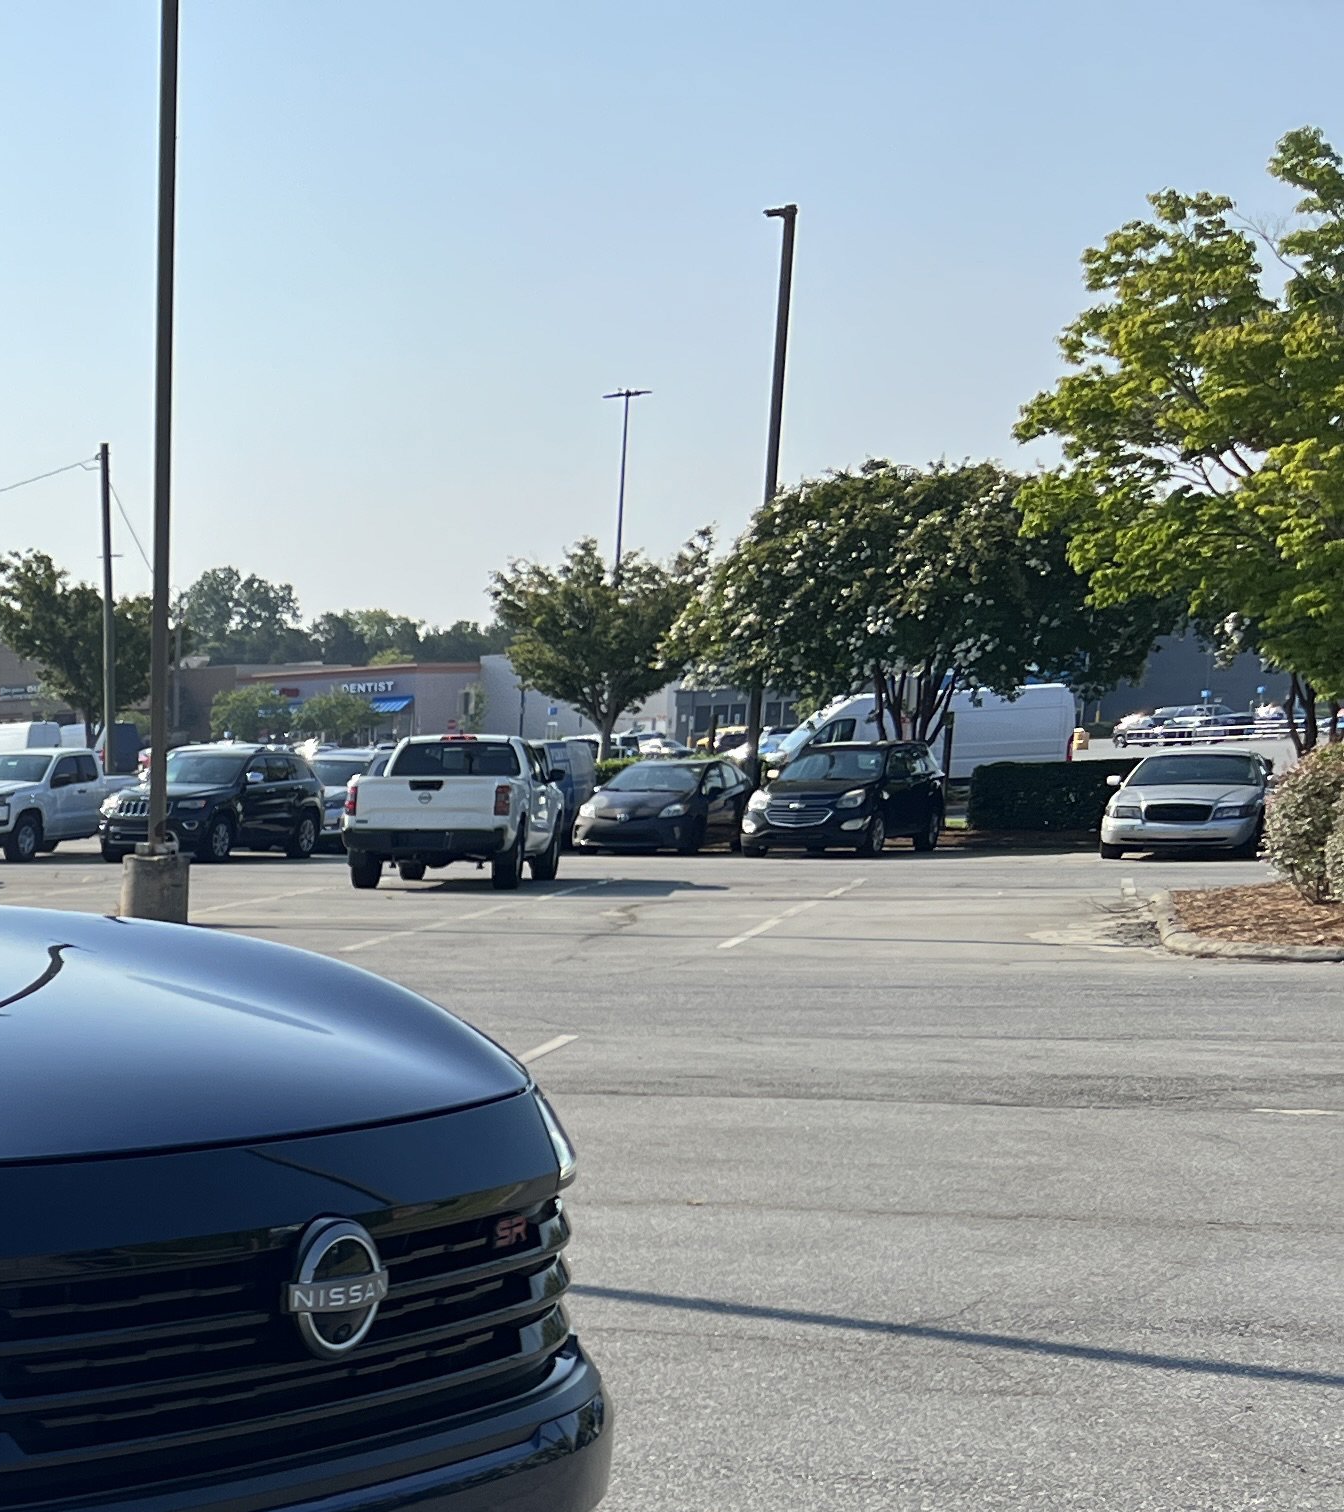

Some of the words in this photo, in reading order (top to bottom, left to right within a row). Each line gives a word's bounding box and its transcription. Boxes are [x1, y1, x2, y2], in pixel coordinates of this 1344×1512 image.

[342, 681, 394, 693] DENTIST
[495, 1215, 528, 1247] SR
[293, 1278, 388, 1308] NISSAN
